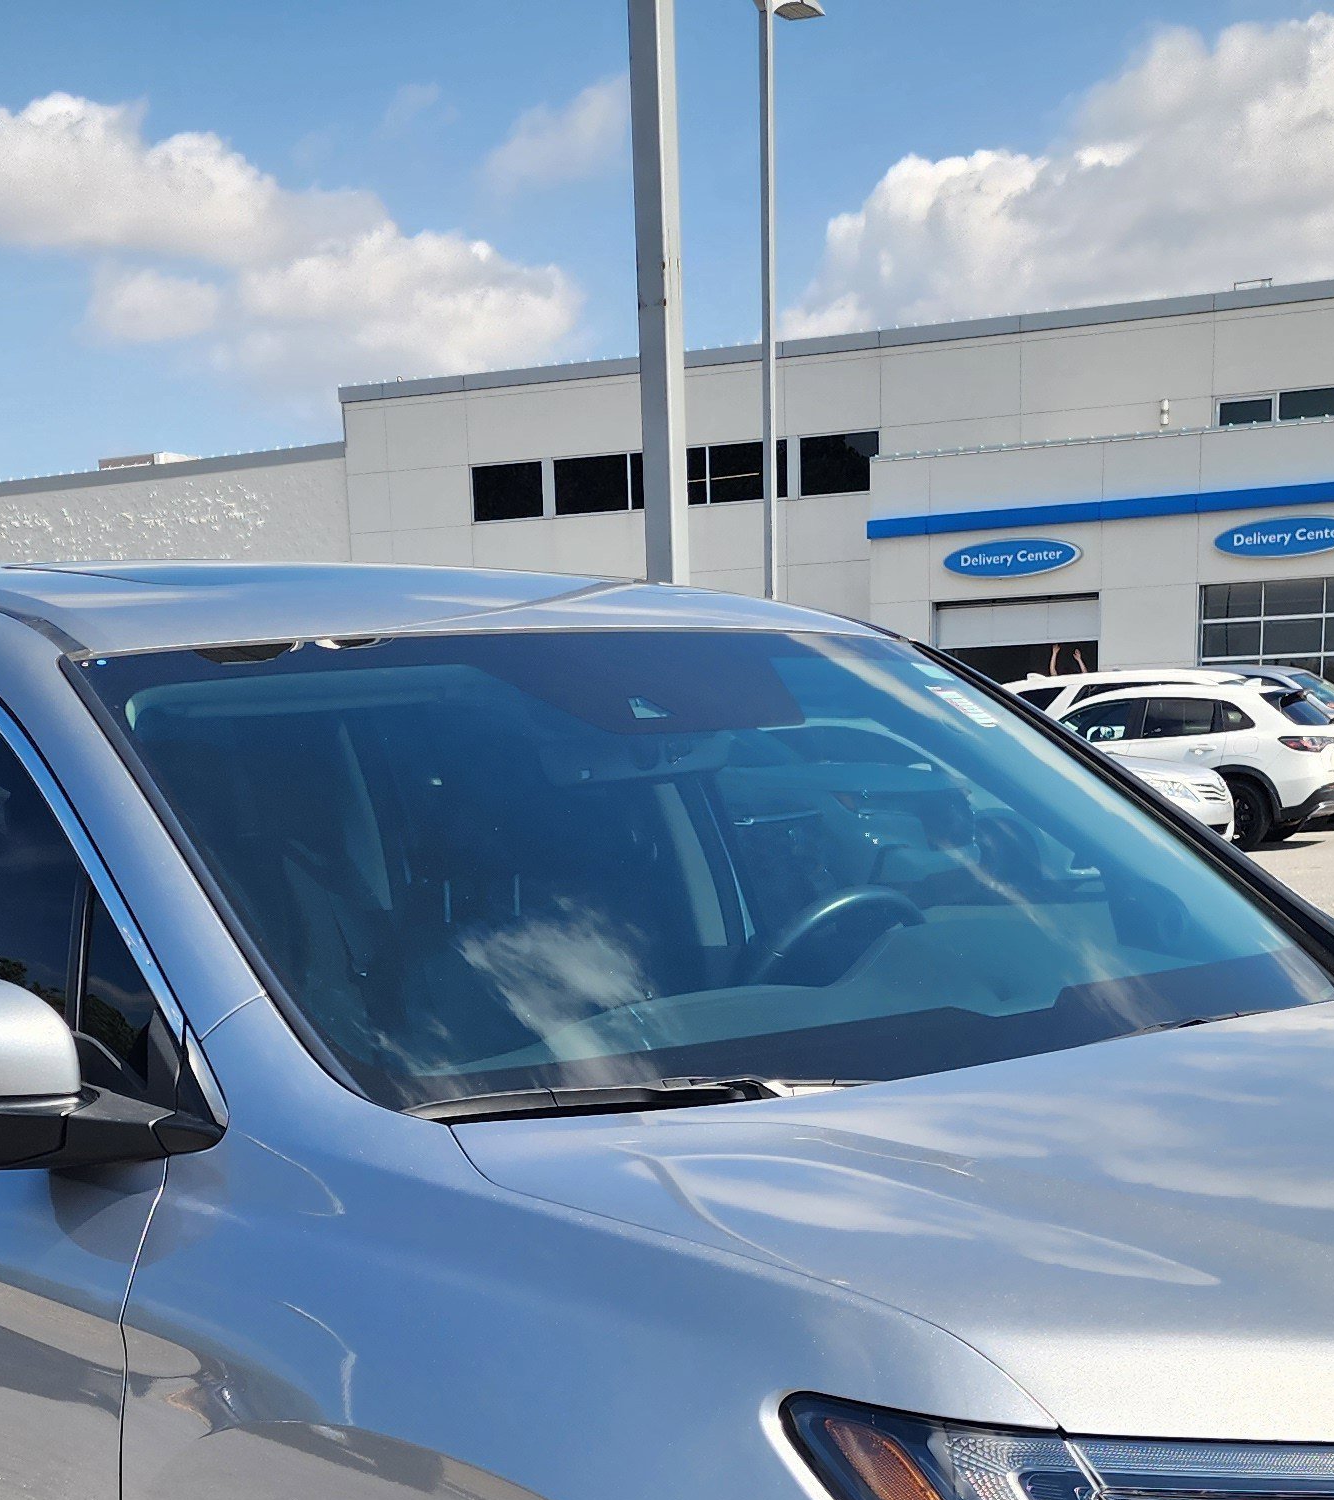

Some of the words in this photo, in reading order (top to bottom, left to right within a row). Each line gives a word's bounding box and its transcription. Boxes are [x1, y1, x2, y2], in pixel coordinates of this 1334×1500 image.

[1232, 531, 1292, 547] Delivery
[960, 553, 1013, 567] Delivery
[1017, 549, 1063, 562] Center
